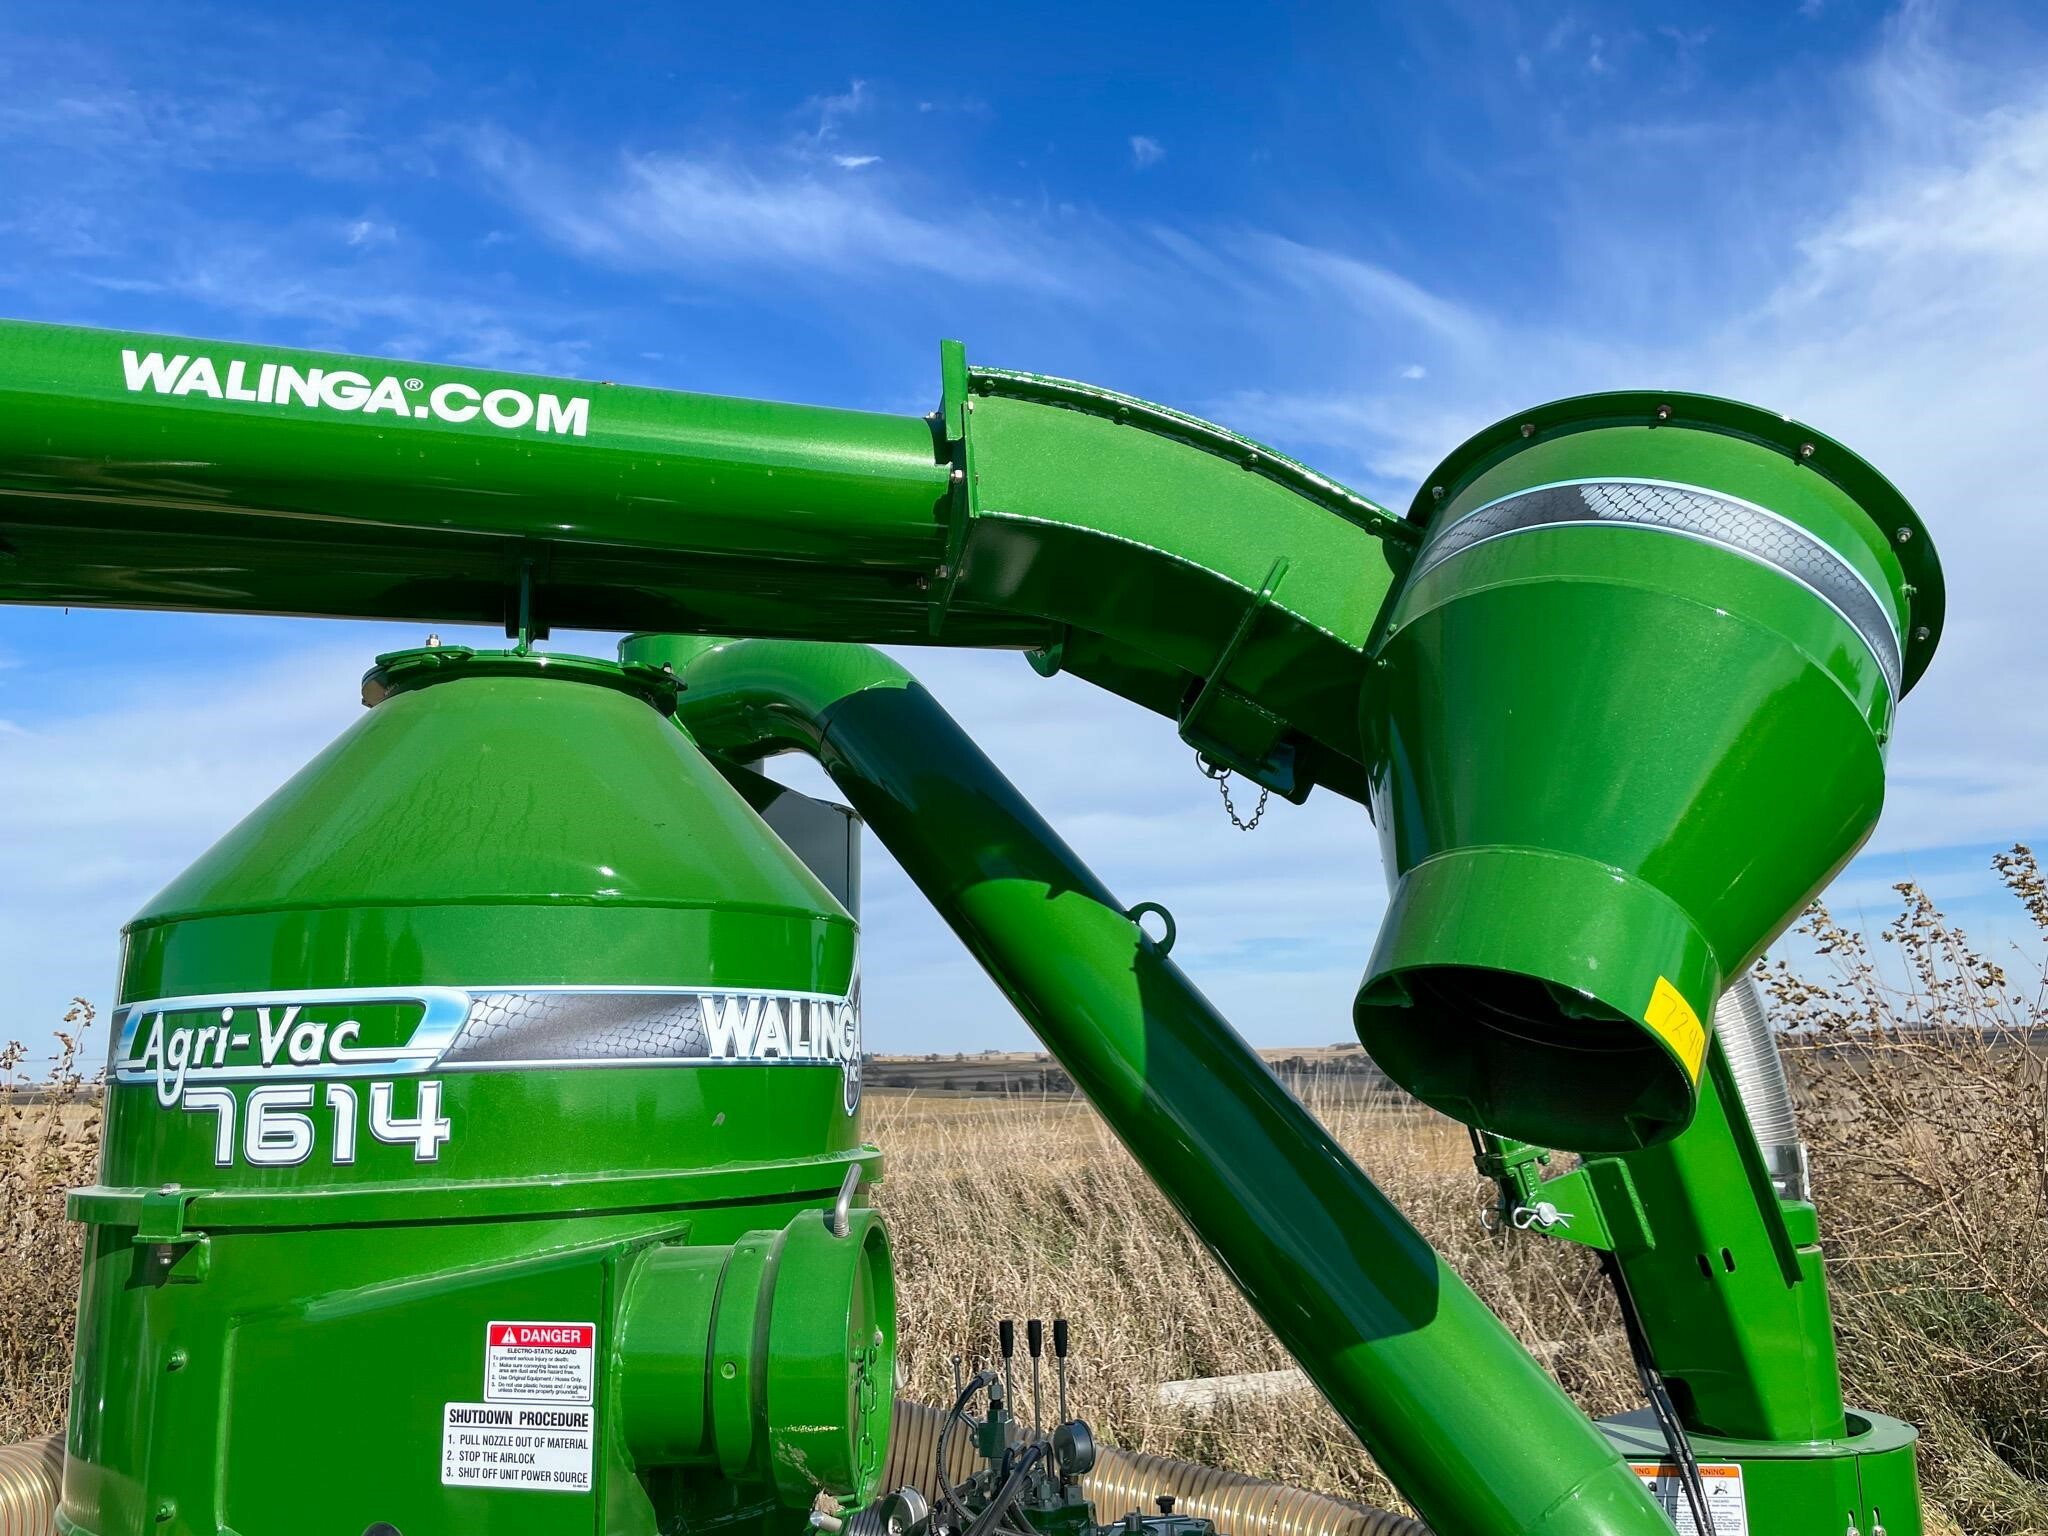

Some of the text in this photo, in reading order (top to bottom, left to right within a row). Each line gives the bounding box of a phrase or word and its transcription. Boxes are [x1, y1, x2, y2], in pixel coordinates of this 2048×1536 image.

[143, 1006, 361, 1106] Agri-Vac
[181, 1081, 450, 1167] 7614
[520, 1329, 581, 1343] DANGER
[449, 1408, 588, 1427] SHUTDOWN PROCEDURE
[448, 1434, 588, 1449] 1. PULL NOZZLE OUT OF MATERIAL
[447, 1450, 535, 1464] 2. STOP THE AIRLOCK
[446, 1466, 587, 1483] 3. SHUT OFF UNIT POWER SOURCE
